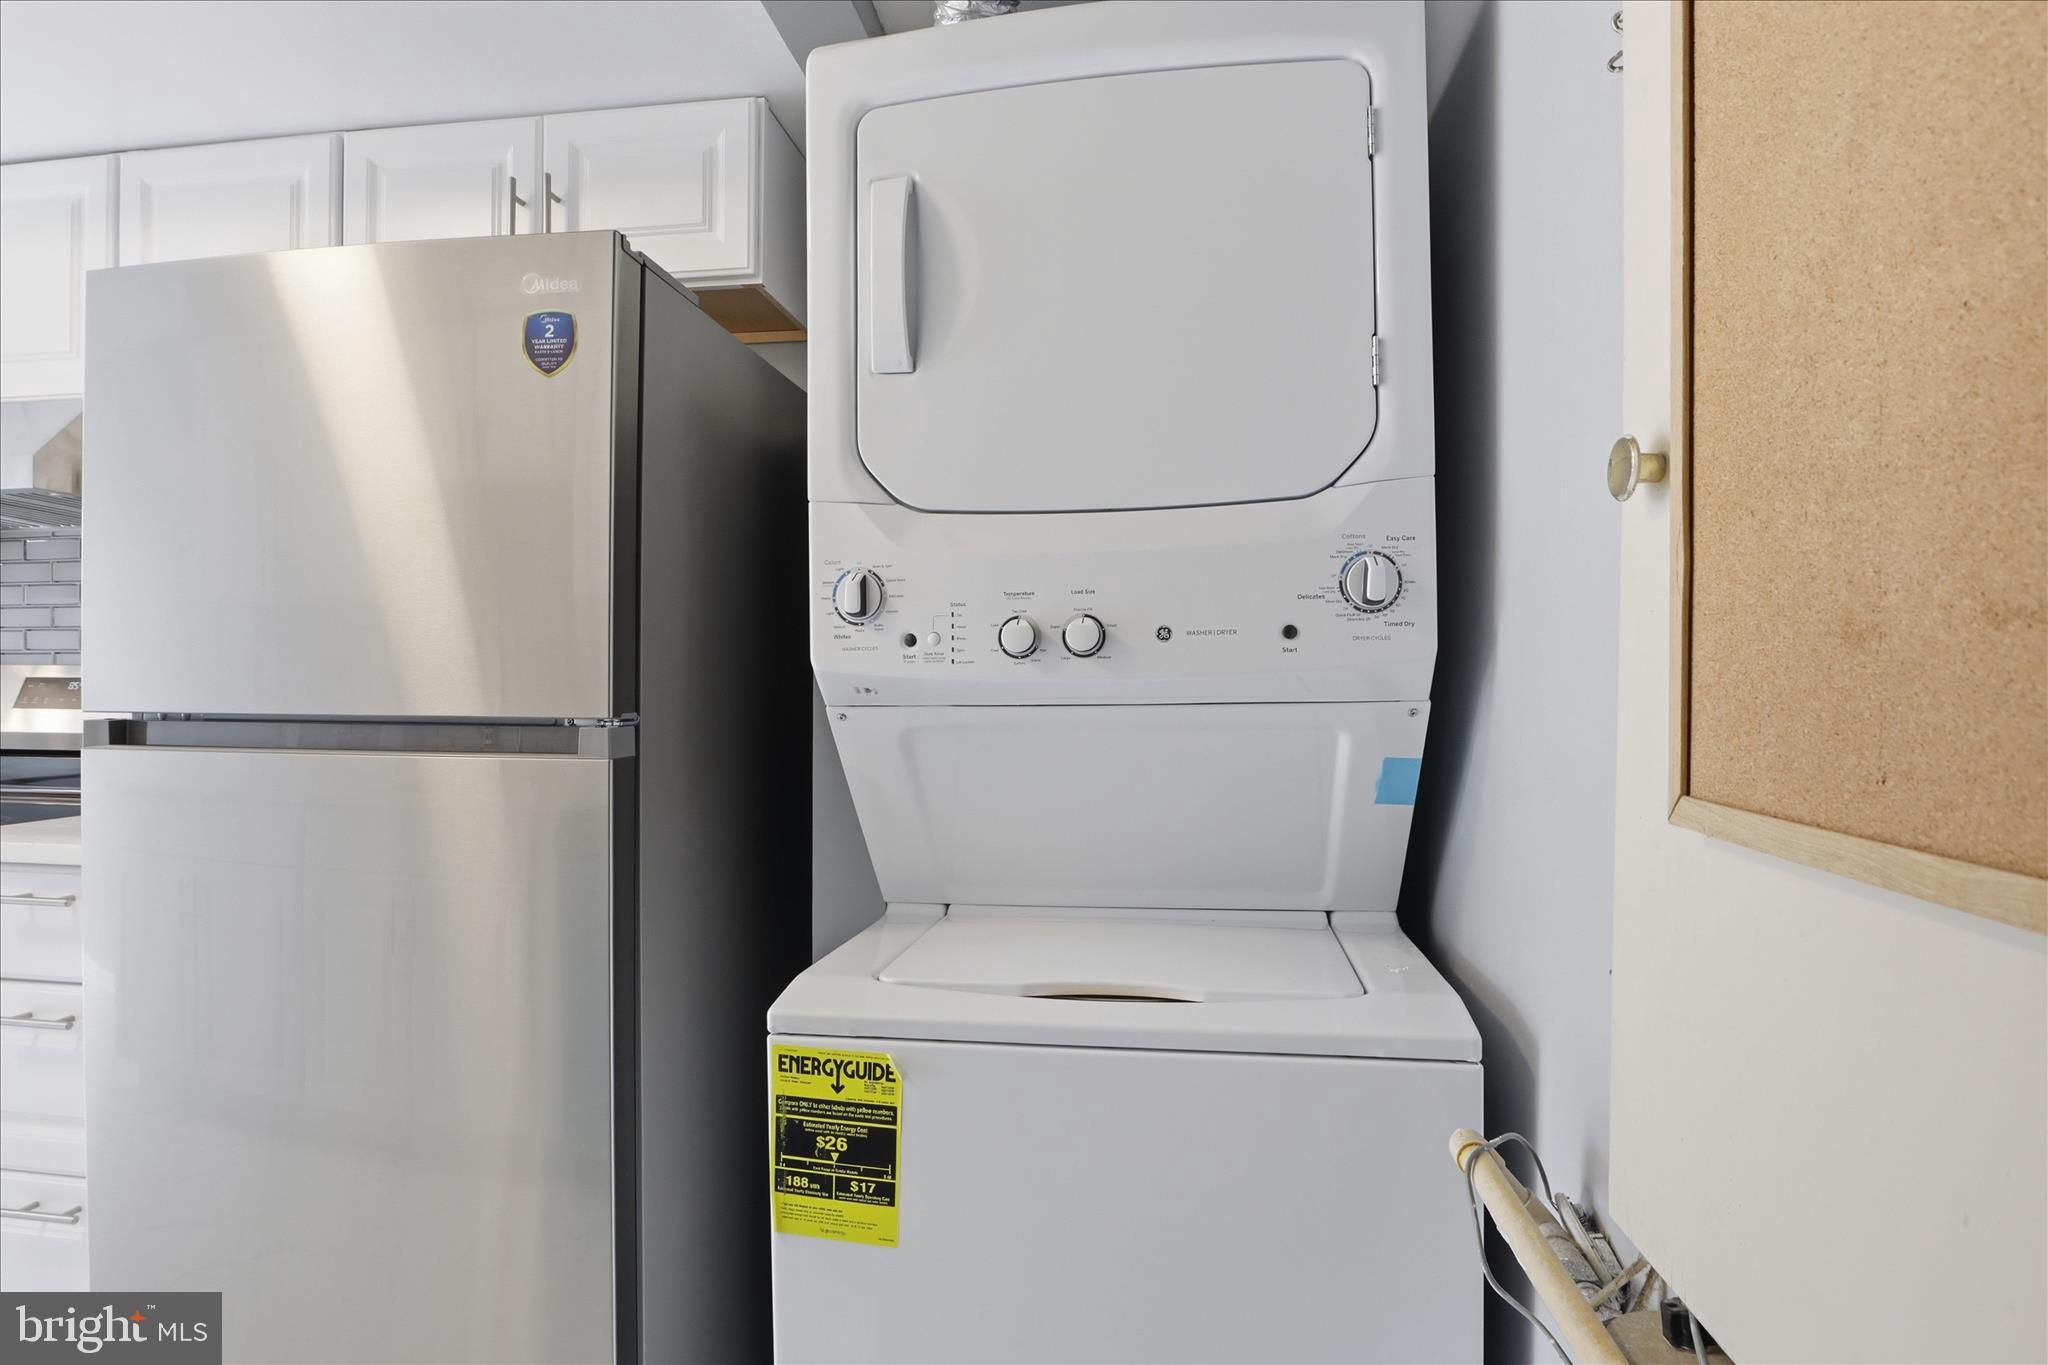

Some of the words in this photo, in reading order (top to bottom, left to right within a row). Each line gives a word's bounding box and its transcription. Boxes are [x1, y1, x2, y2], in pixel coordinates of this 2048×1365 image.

[544, 324, 554, 337] 2
[778, 1054, 896, 1085] ENERGYGUIDE
[840, 1124, 856, 1134] Energy
[816, 1136, 848, 1152] $26
[786, 1175, 809, 1188] 188
[850, 1180, 876, 1194] $17
